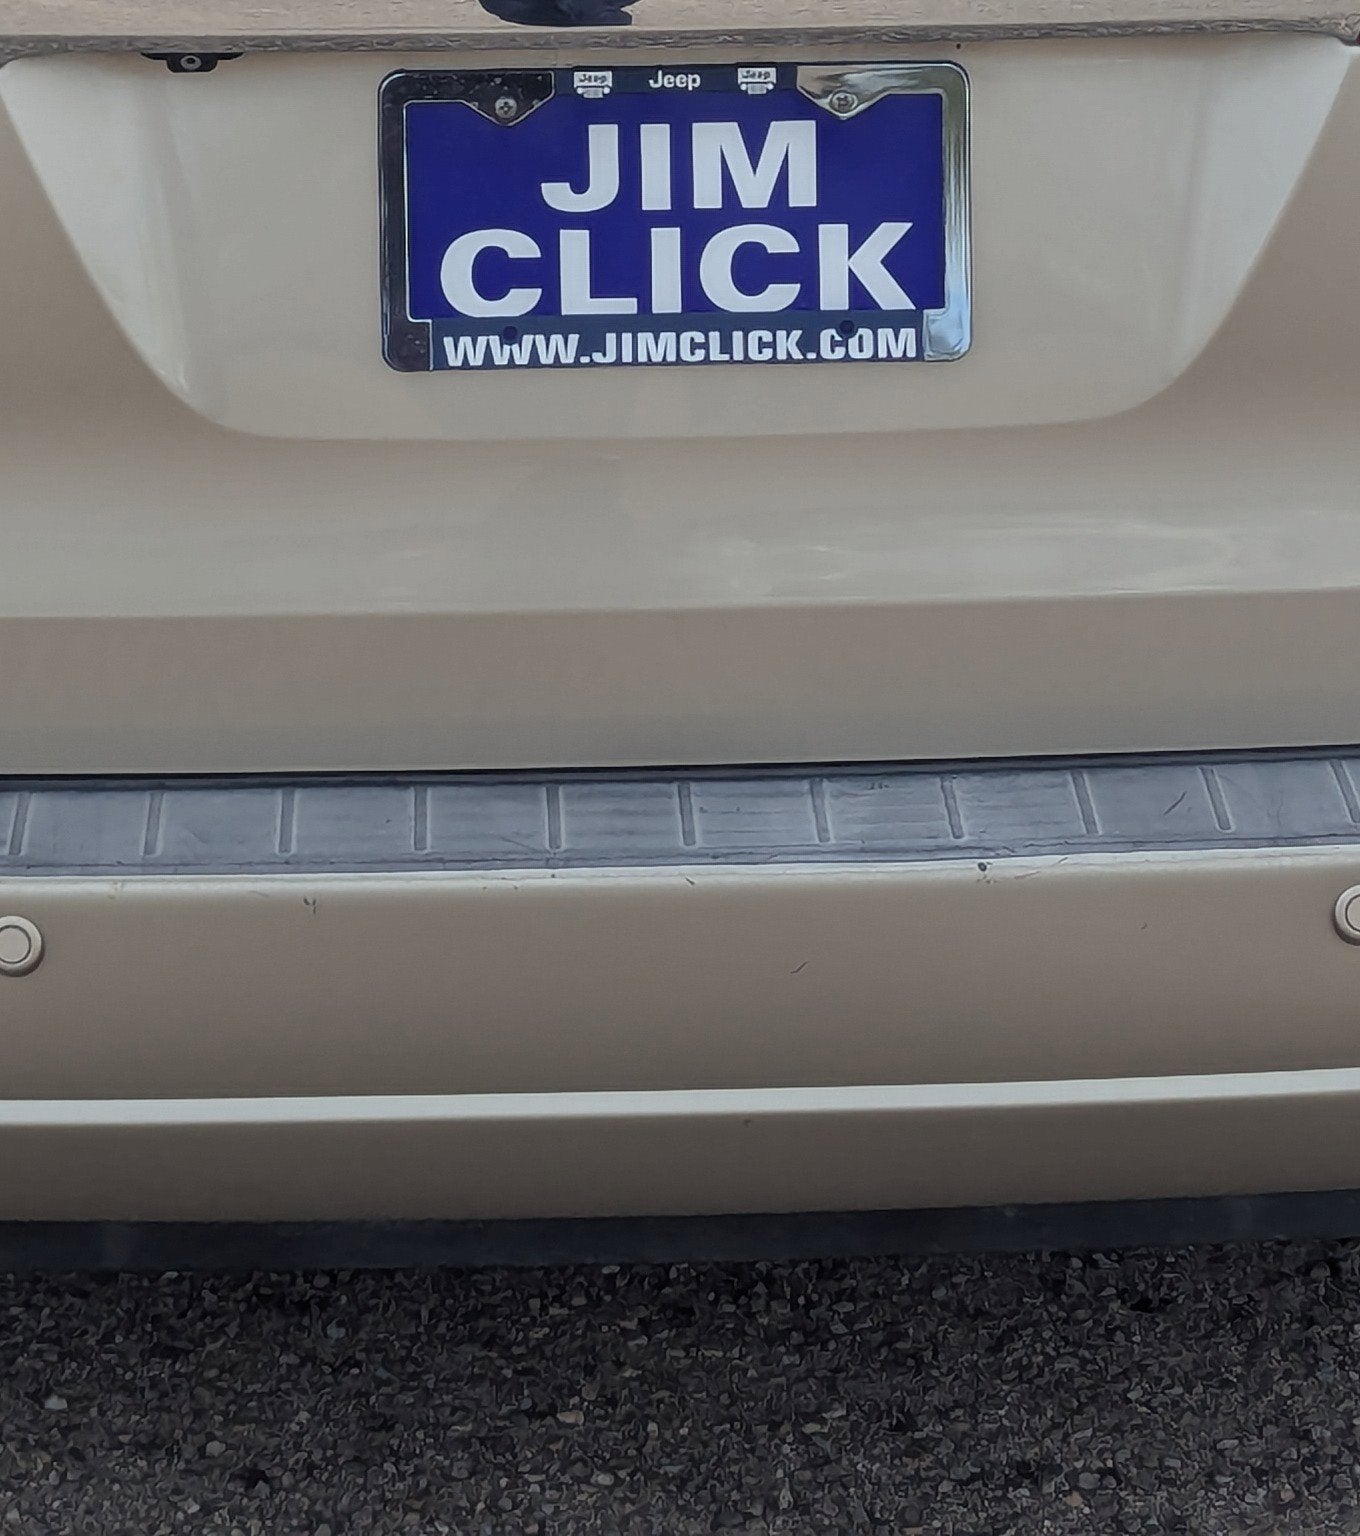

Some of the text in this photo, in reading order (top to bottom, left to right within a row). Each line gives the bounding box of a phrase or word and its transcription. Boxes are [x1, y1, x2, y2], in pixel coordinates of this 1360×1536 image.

[648, 69, 702, 91] Jeep
[541, 120, 817, 212] JIM
[440, 222, 916, 318] CLICK
[443, 328, 917, 366] WWW.JIMCLICK.COM
